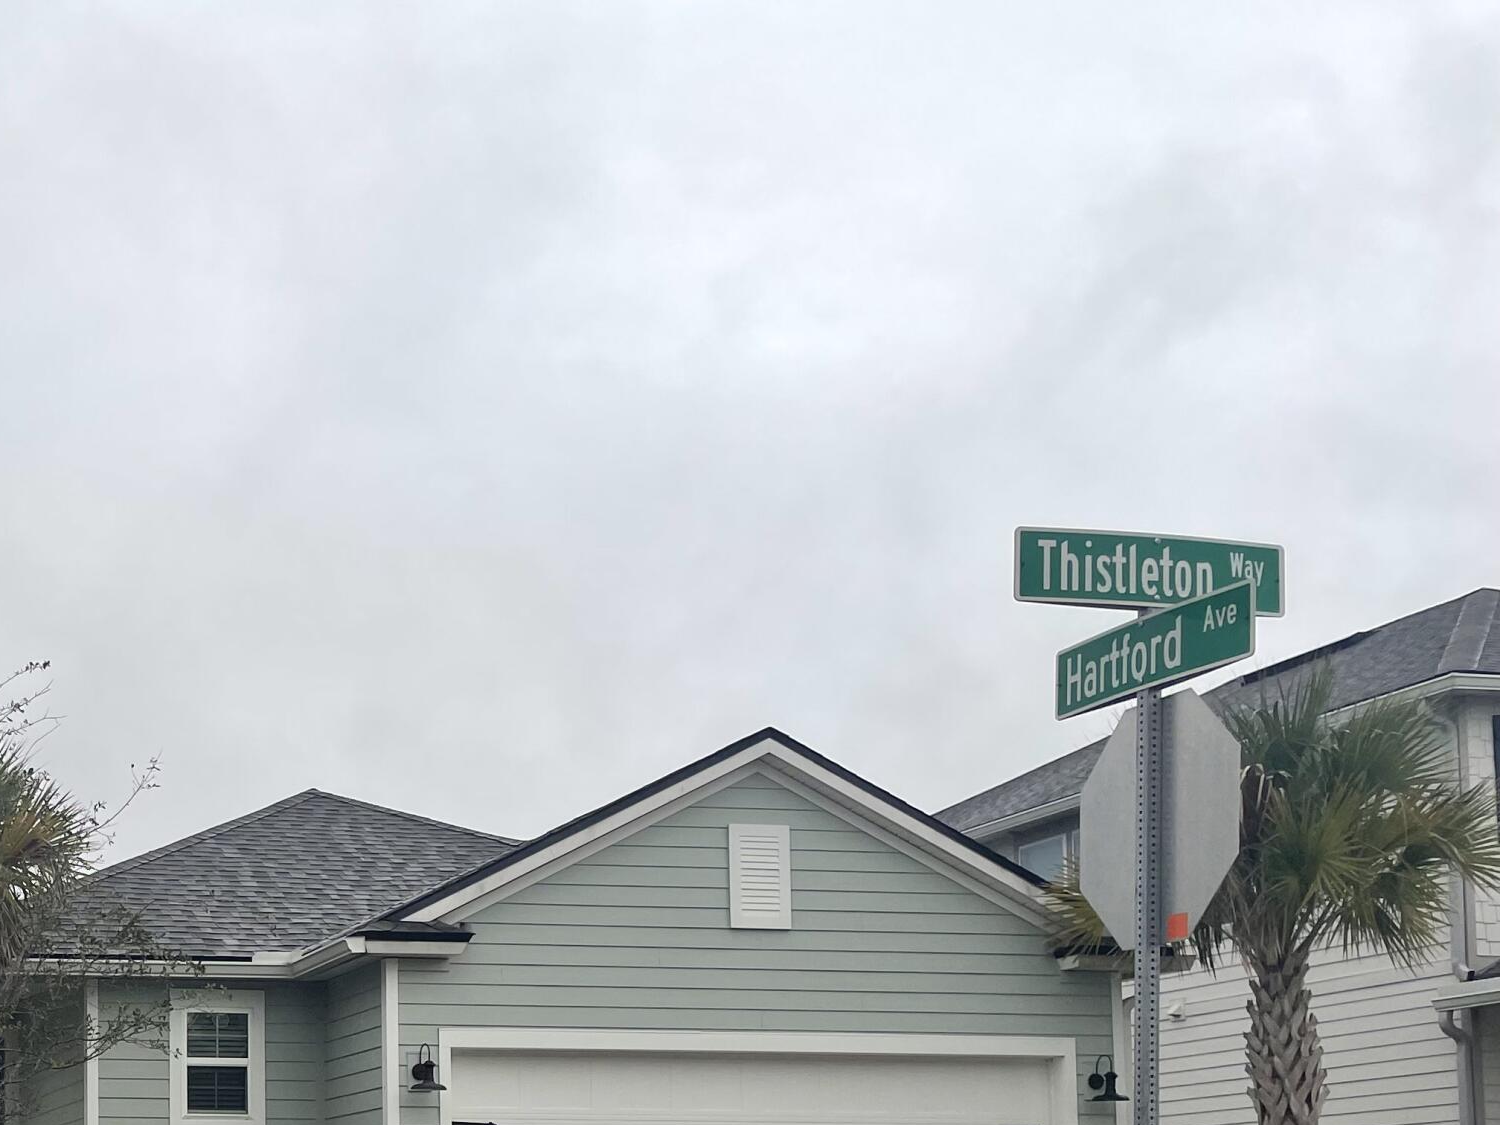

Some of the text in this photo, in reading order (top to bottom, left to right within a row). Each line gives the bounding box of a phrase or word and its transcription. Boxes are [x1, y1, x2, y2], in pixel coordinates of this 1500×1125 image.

[1038, 539, 1264, 598] Thistleton Way
[1066, 603, 1237, 706] Hartford Ave
